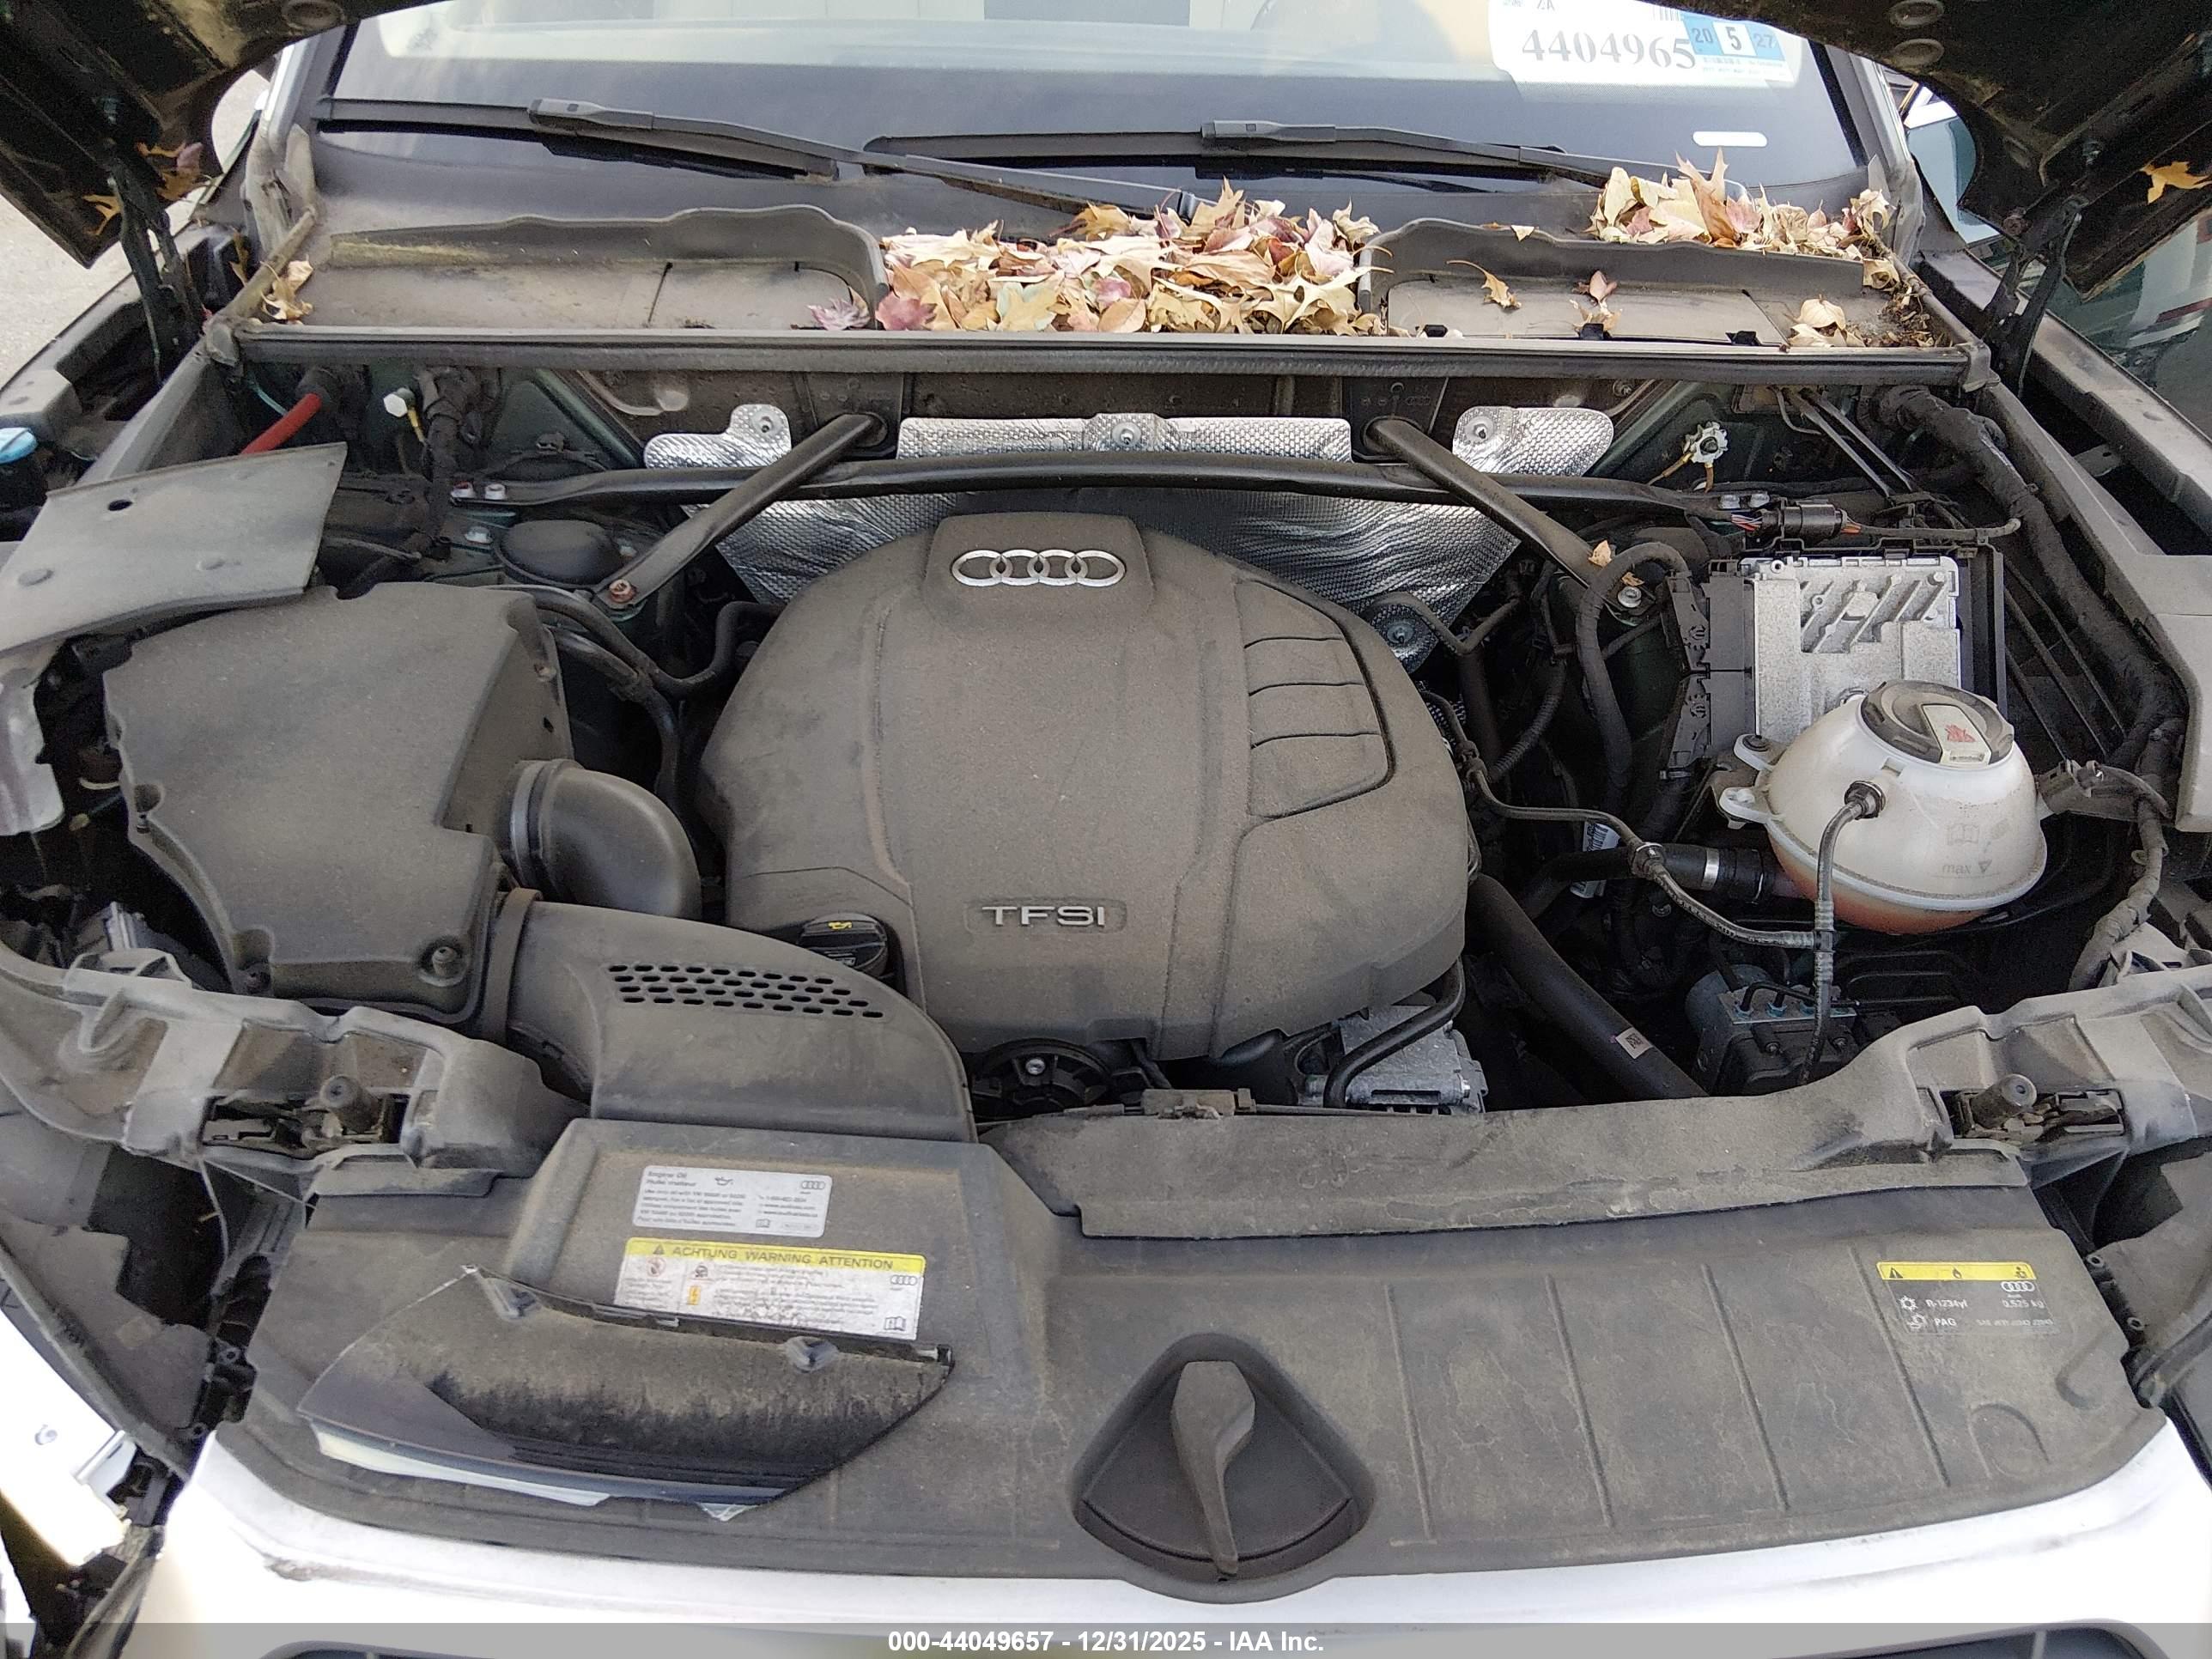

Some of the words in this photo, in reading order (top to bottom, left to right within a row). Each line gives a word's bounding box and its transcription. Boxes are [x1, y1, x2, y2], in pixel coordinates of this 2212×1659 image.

[1522, 29, 1696, 69] 4404965
[1692, 27, 1714, 44] 20
[1725, 27, 1742, 51] 5
[1942, 865, 1971, 874] max
[981, 906, 1105, 927] TFSI
[672, 1246, 738, 1259] ACHTUNG
[745, 1251, 811, 1265] WARNING
[818, 1255, 894, 1269] ATTENTION
[1934, 1317, 1958, 1327] PAG
